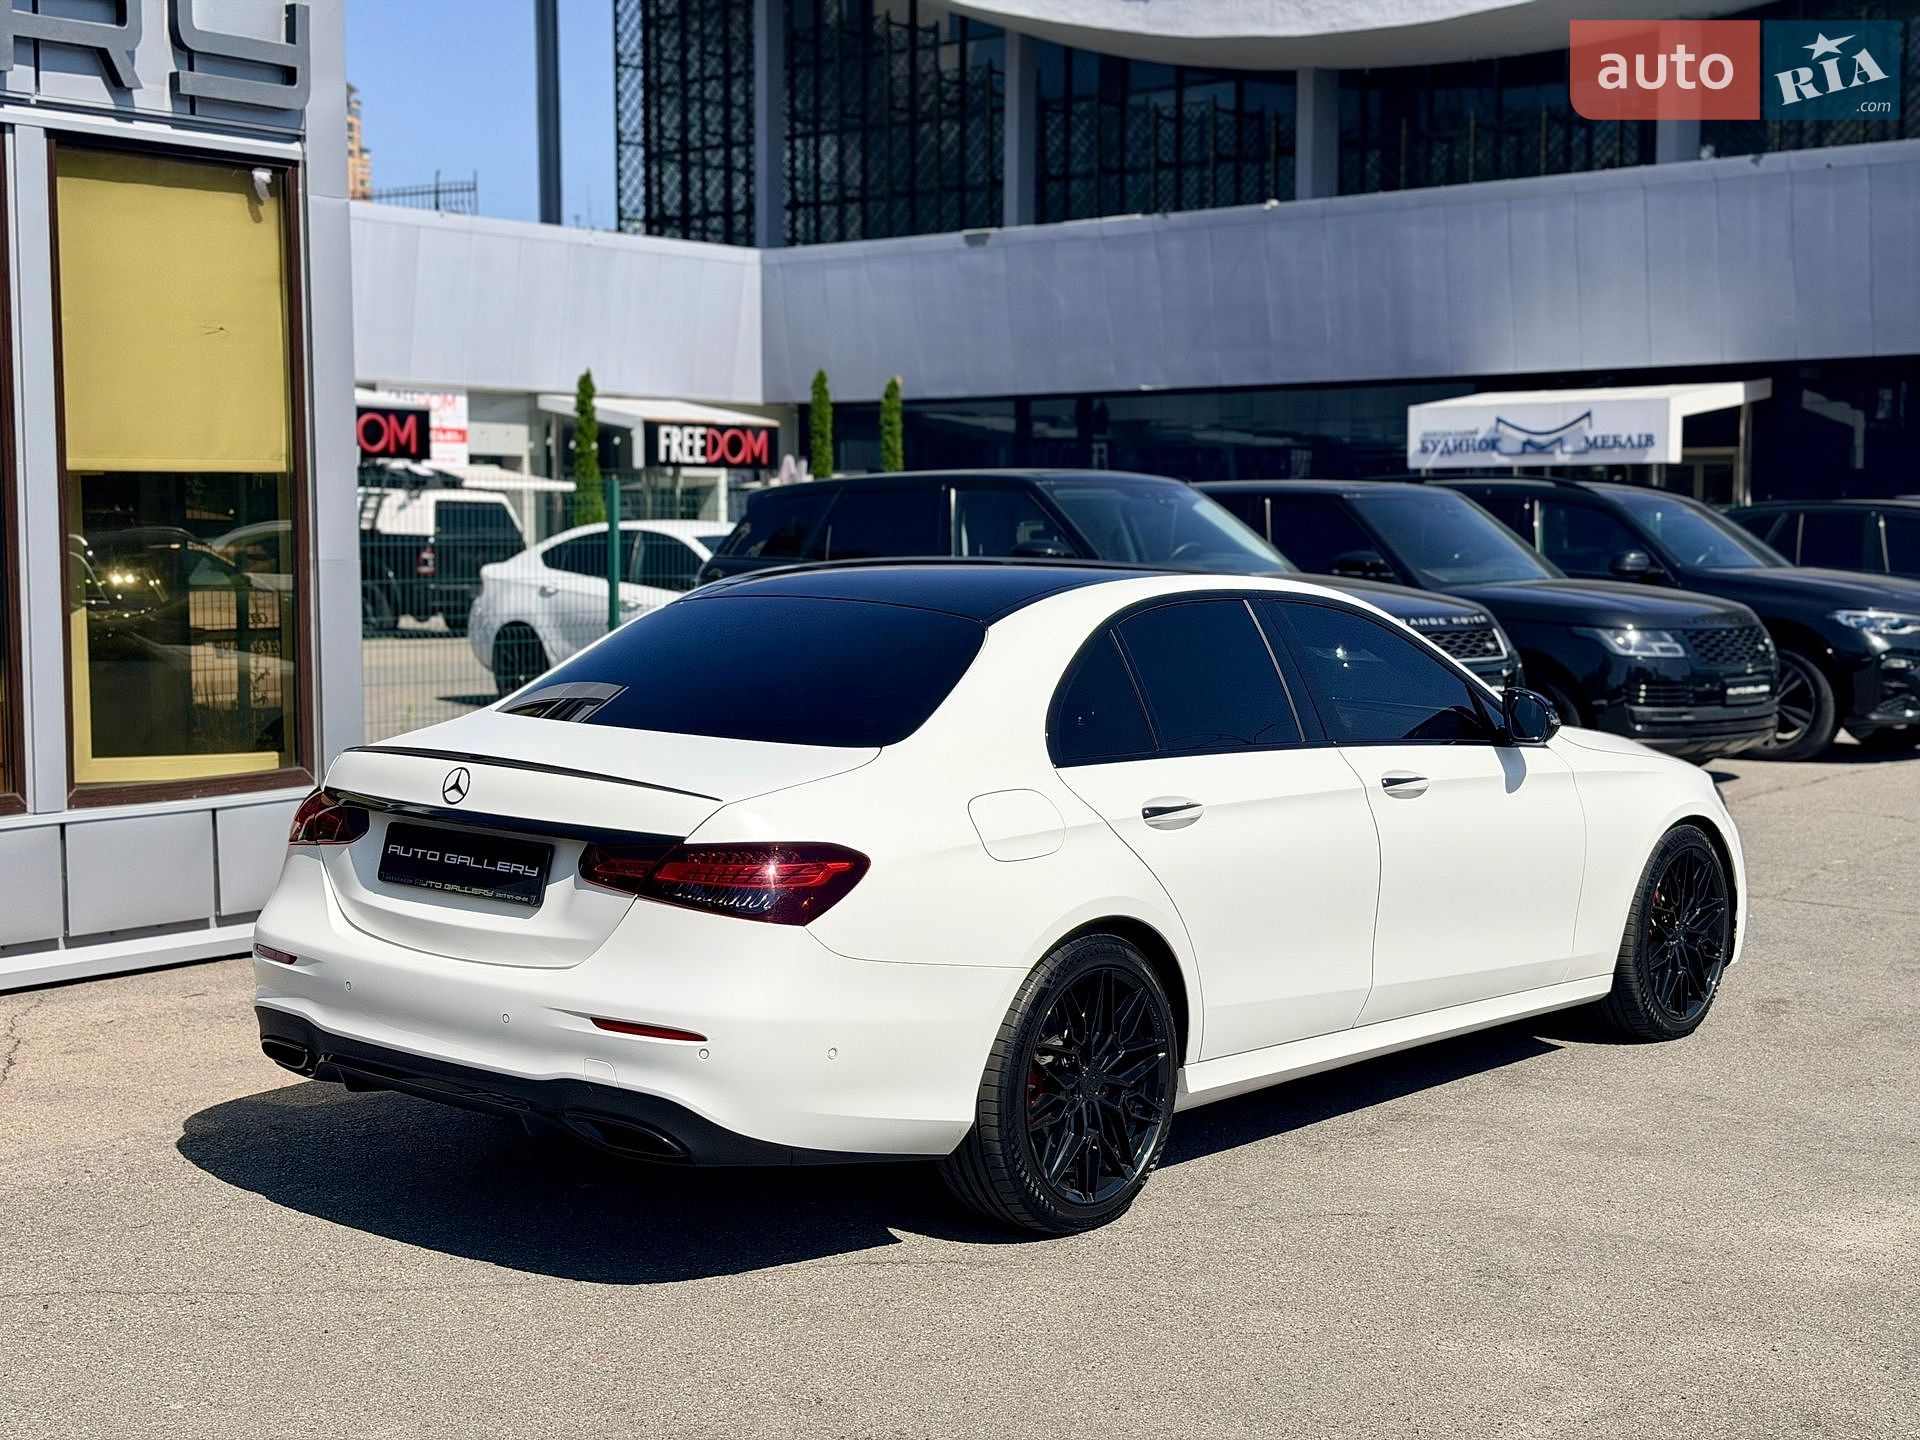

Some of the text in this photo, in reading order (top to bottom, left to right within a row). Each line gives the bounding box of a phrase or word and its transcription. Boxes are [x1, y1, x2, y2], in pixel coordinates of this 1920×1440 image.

[658, 425, 768, 465] FREEDOM
[387, 844, 539, 877] AUTO GALLERY
